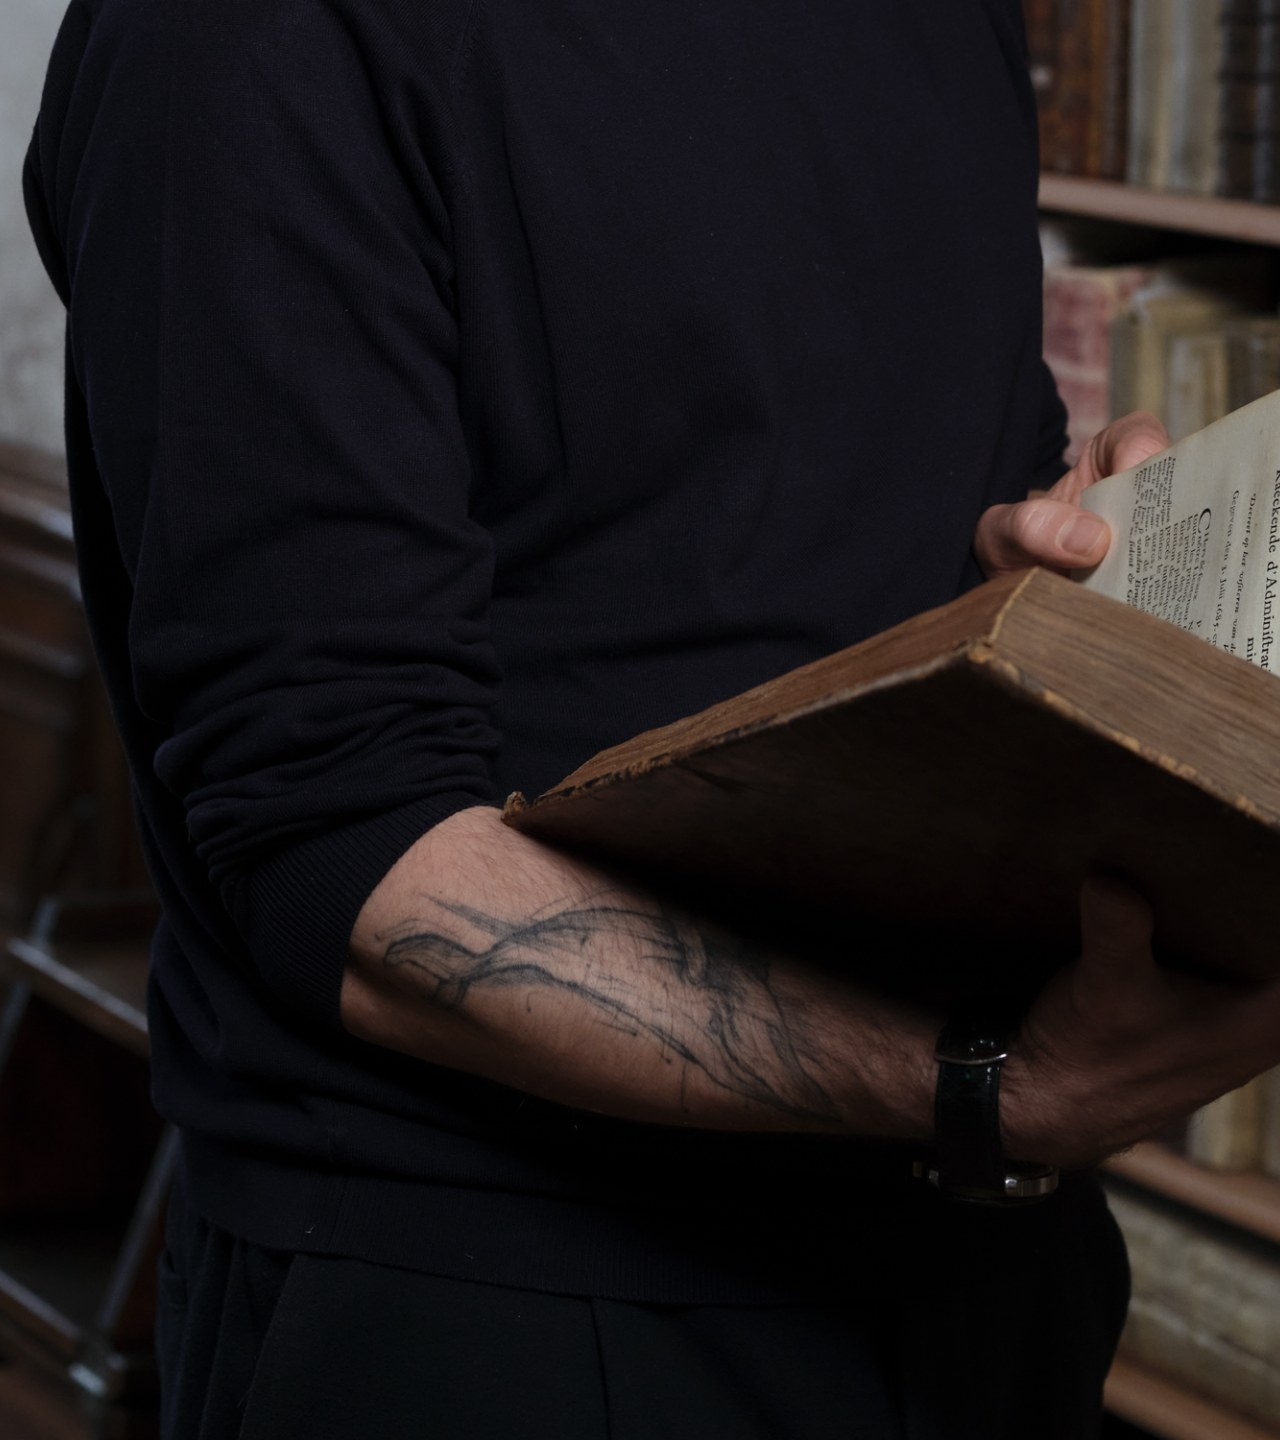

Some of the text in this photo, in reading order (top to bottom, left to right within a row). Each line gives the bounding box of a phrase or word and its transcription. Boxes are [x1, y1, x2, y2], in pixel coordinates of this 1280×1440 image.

[1227, 490, 1239, 537] Gegeven
[1246, 493, 1256, 533] Decreet
[1191, 513, 1199, 546] toutes
[1224, 541, 1232, 561] den
[1241, 551, 1249, 566] het
[1213, 603, 1223, 631] 1685.
